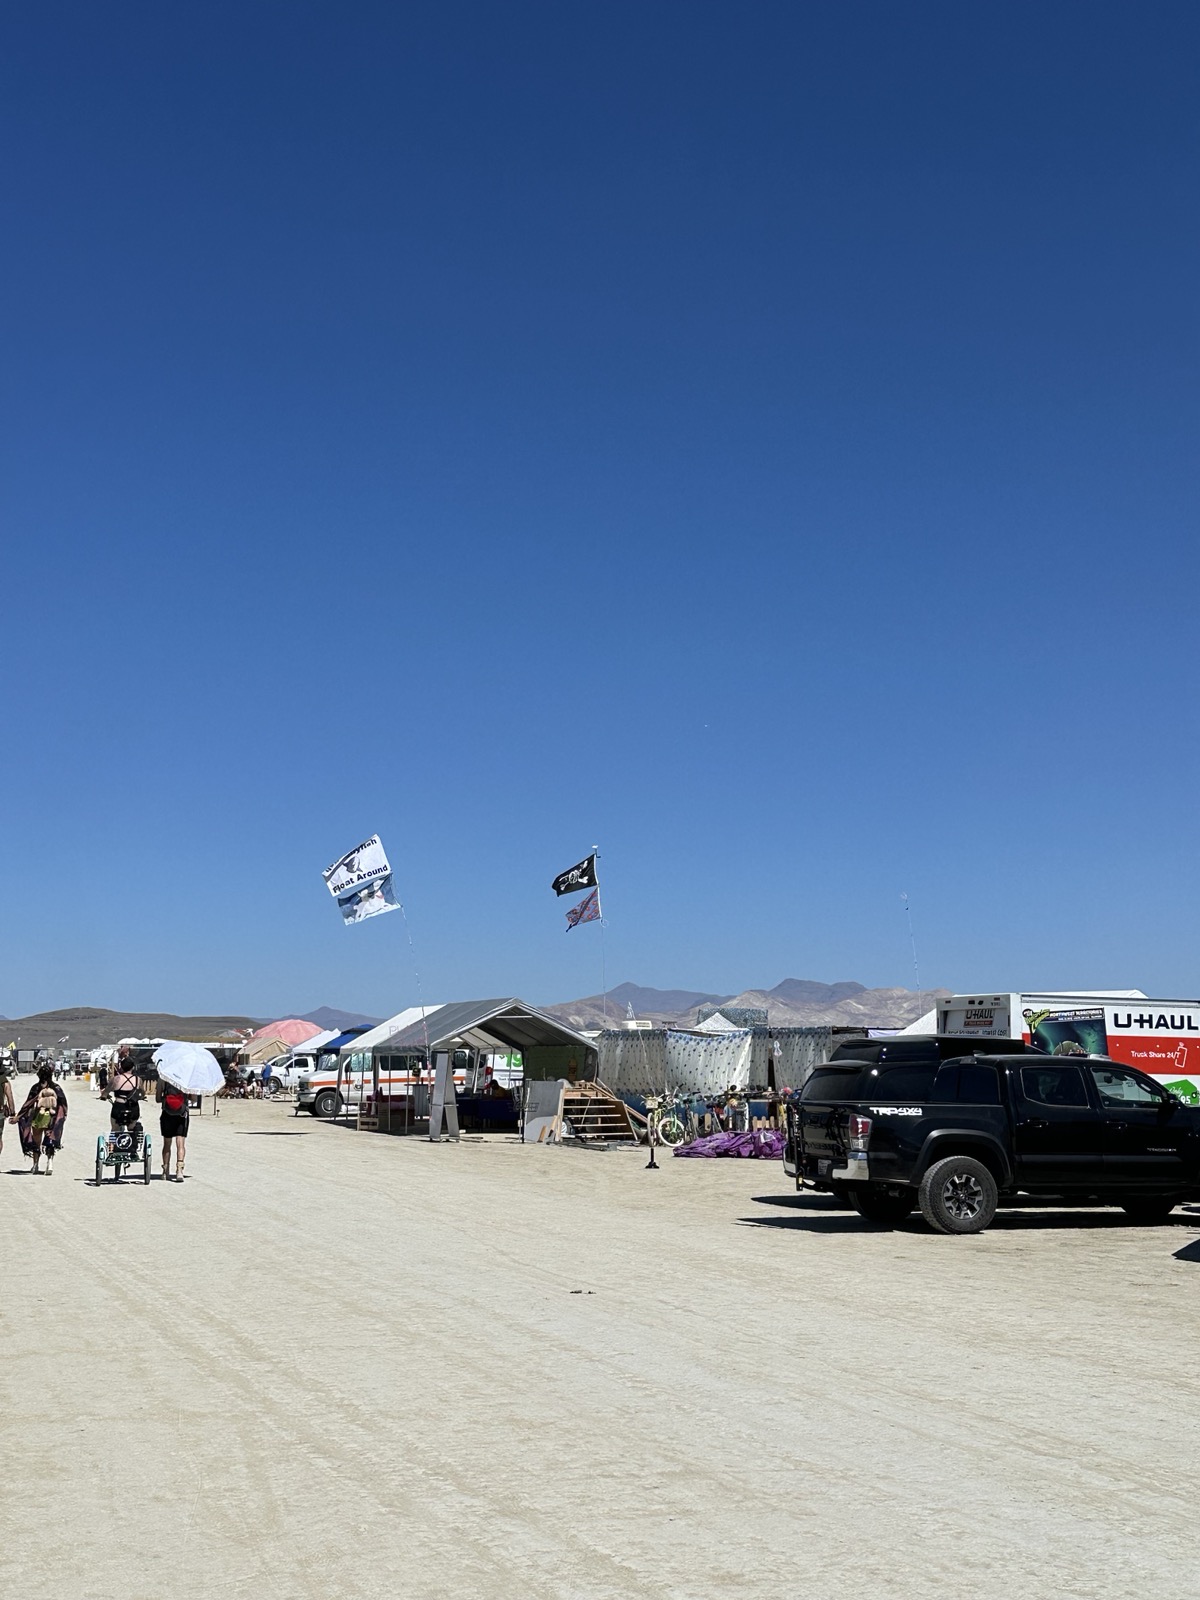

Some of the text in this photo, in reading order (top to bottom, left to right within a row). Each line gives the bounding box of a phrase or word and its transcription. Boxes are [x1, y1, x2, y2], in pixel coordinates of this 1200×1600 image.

[333, 878, 354, 893] Float
[357, 865, 388, 881] Around
[965, 1008, 994, 1020] U-HAUL
[1114, 1013, 1199, 1030] U-HAUL
[1130, 1050, 1148, 1058] Truck
[1166, 1051, 1181, 1059] 24/7
